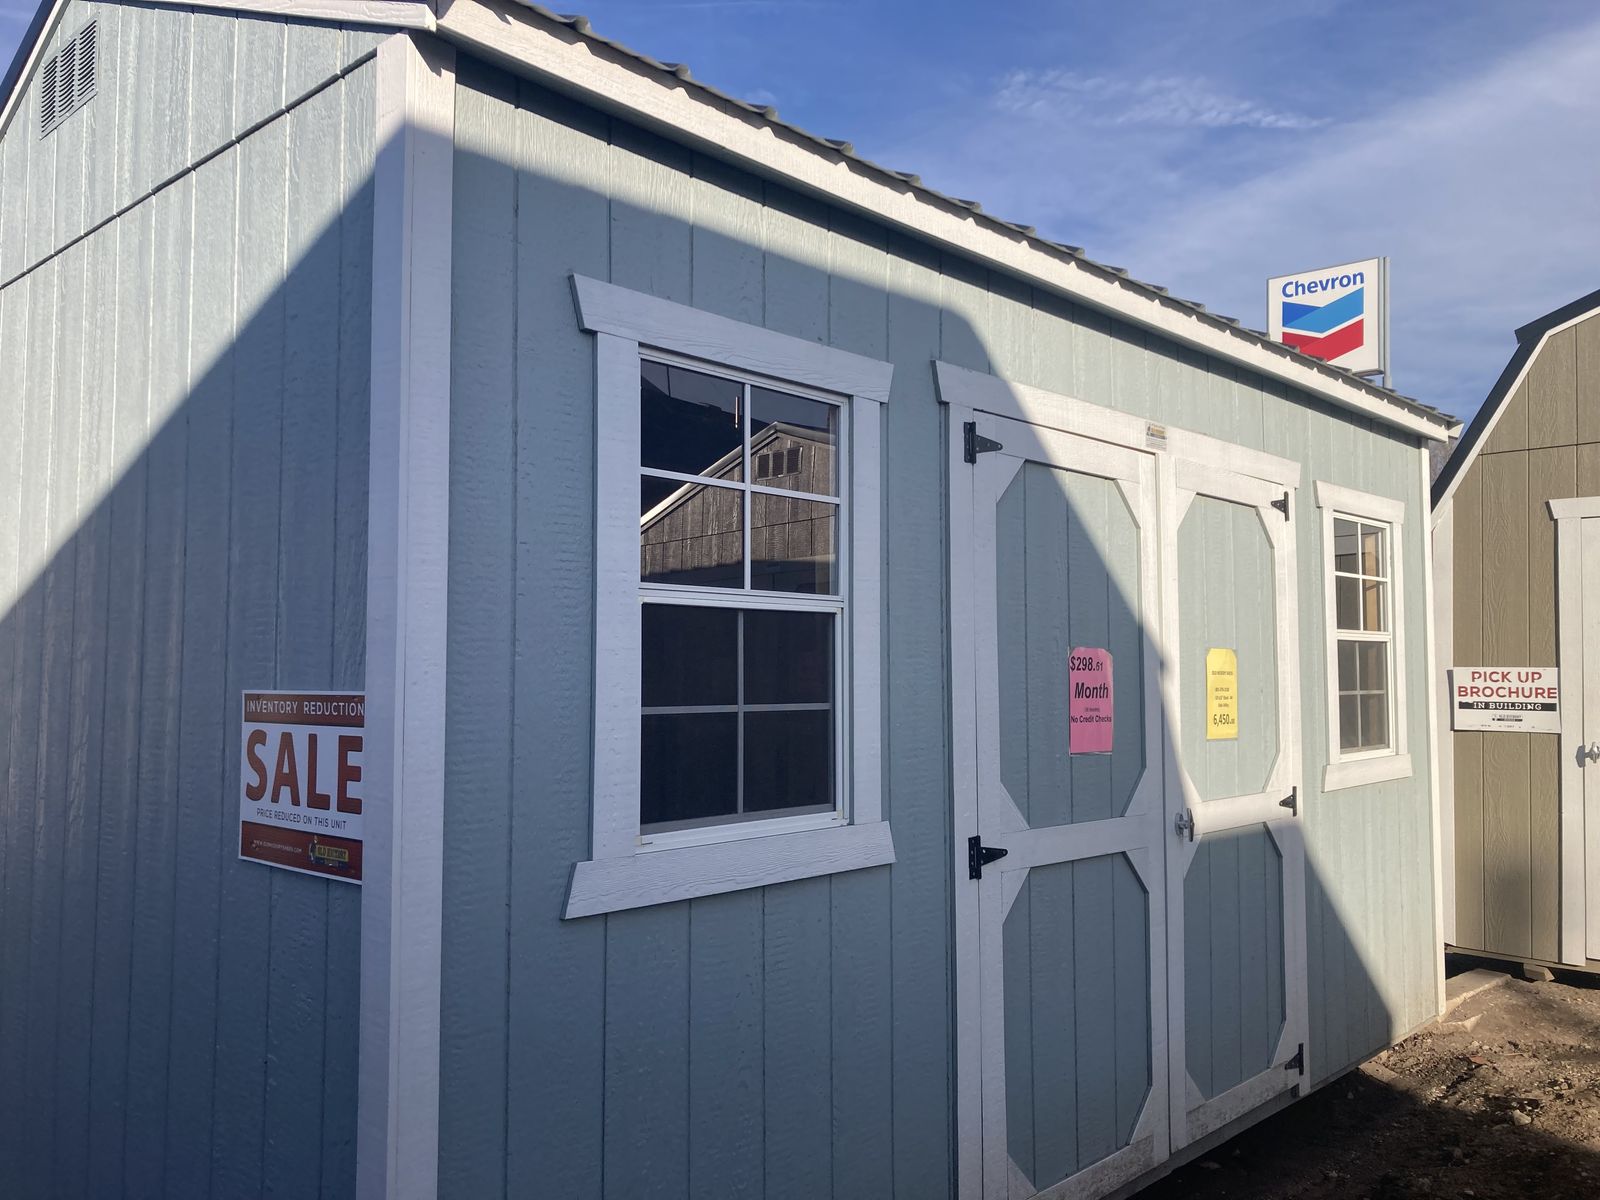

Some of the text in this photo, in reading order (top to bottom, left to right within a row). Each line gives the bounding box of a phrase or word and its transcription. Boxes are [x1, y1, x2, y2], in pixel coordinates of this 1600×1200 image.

[1282, 271, 1364, 298] Chevron
[1070, 656, 1103, 672] $298.61
[1471, 671, 1542, 683] PICK UP
[1074, 682, 1109, 699] Month
[1457, 686, 1557, 699] BROCHURE
[247, 700, 364, 716] INVENTORY REDUCTION
[1489, 702, 1542, 710] BUILDING
[1071, 715, 1079, 723] No
[246, 729, 363, 814] SALE
[256, 808, 347, 830] PRICE REDUCED ON THIS UNIT
